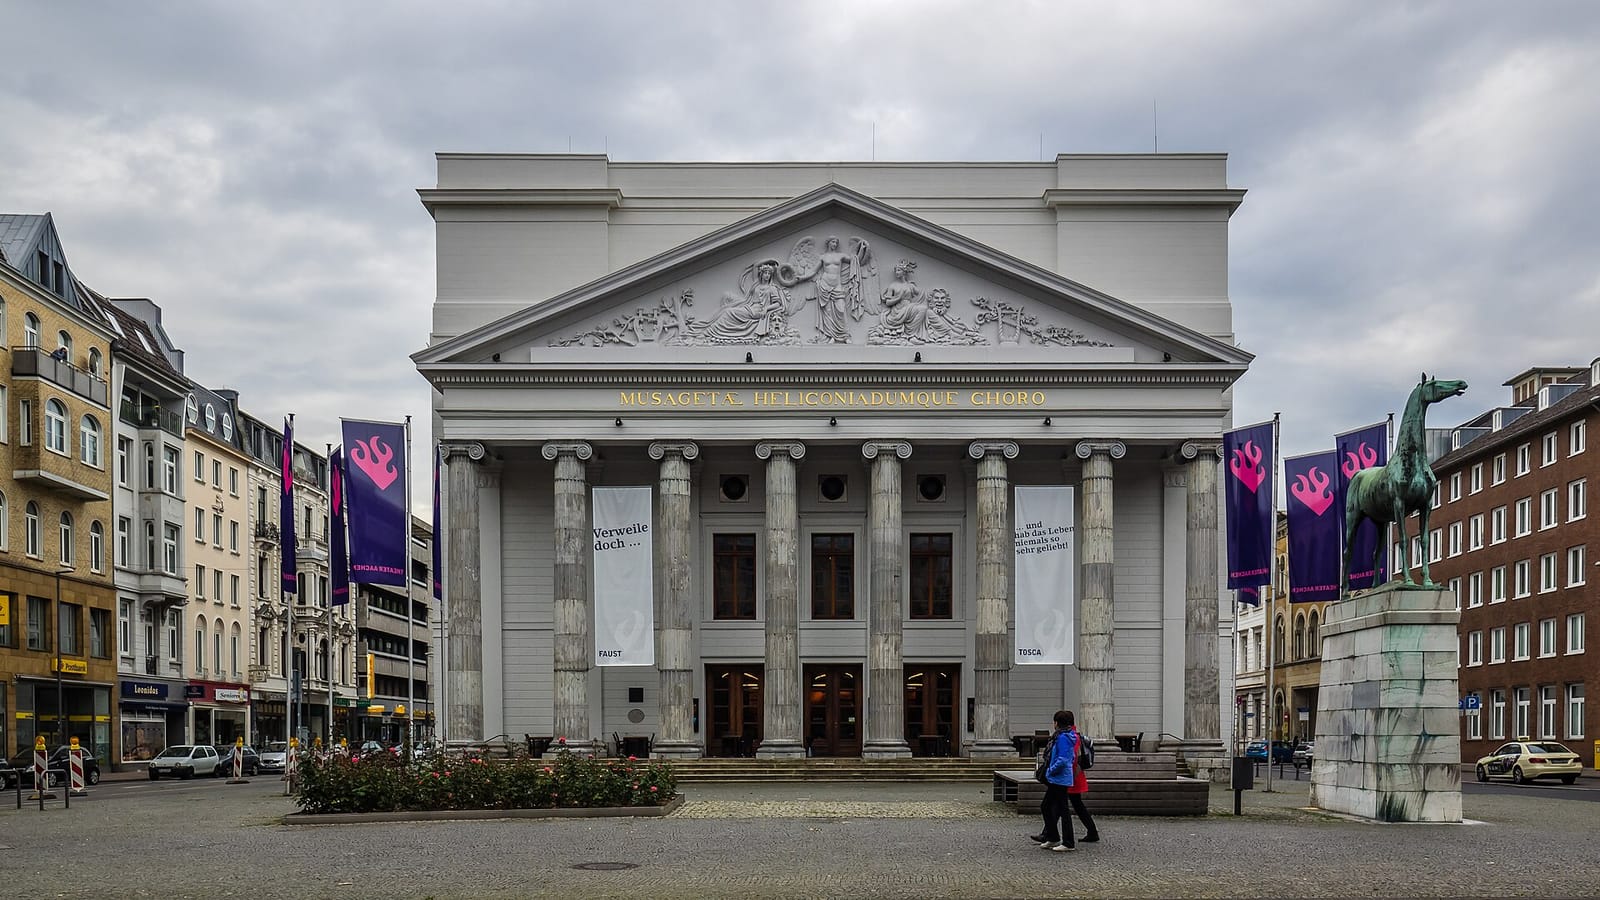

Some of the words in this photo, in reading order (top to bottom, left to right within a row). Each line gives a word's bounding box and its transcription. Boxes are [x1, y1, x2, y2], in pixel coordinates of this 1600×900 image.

[753, 391, 959, 408] HELICONIADUMQUE
[971, 391, 1045, 406] CHORO
[593, 523, 648, 538] Verweile
[1026, 521, 1043, 530] und
[1048, 526, 1074, 535] Leben
[595, 539, 625, 551] doch
[1015, 537, 1048, 546] niemals
[1036, 542, 1068, 554] geliebt!
[134, 684, 159, 695] Leonidas
[1468, 698, 1477, 708] P
